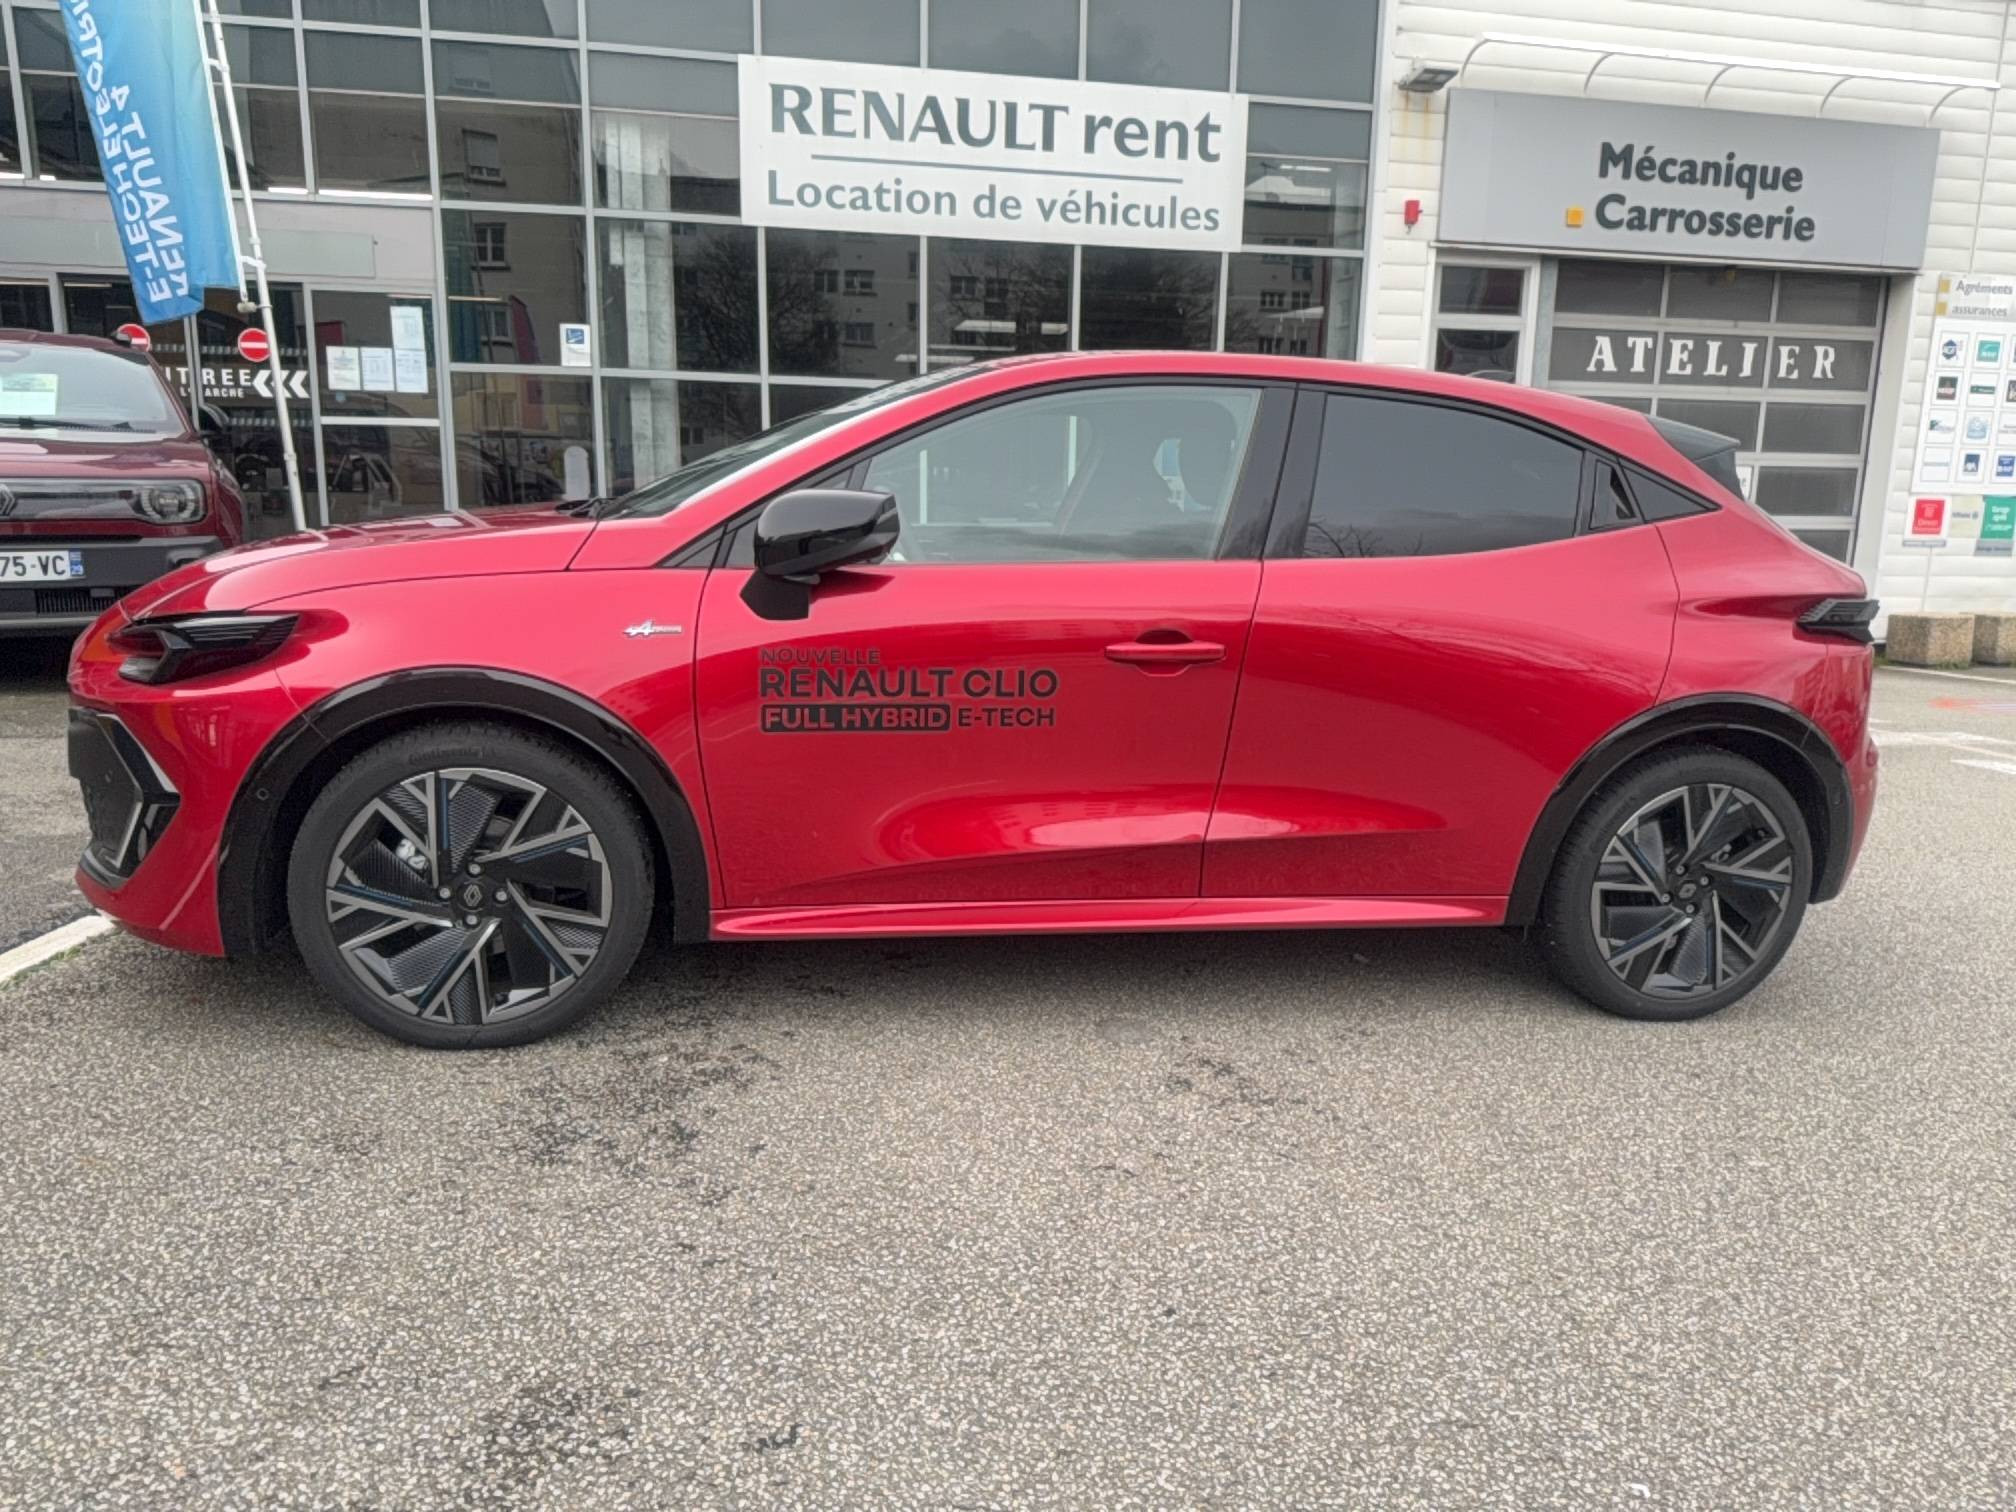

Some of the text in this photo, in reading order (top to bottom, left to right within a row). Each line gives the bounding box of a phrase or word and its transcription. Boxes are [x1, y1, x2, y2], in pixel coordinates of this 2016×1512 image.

[768, 82, 1222, 163] RENAULT rent
[1598, 141, 1803, 200] Mécanique
[768, 169, 1220, 232] Location de véhicules
[1595, 193, 1815, 242] Carrosserie
[1951, 305, 2008, 317] assurances
[1586, 335, 1836, 379] ATELIER
[760, 648, 880, 664] NOUVELLE
[760, 668, 1058, 698] RENAULT CLIO
[765, 707, 1055, 729] FULL HYBRID E-TECH
